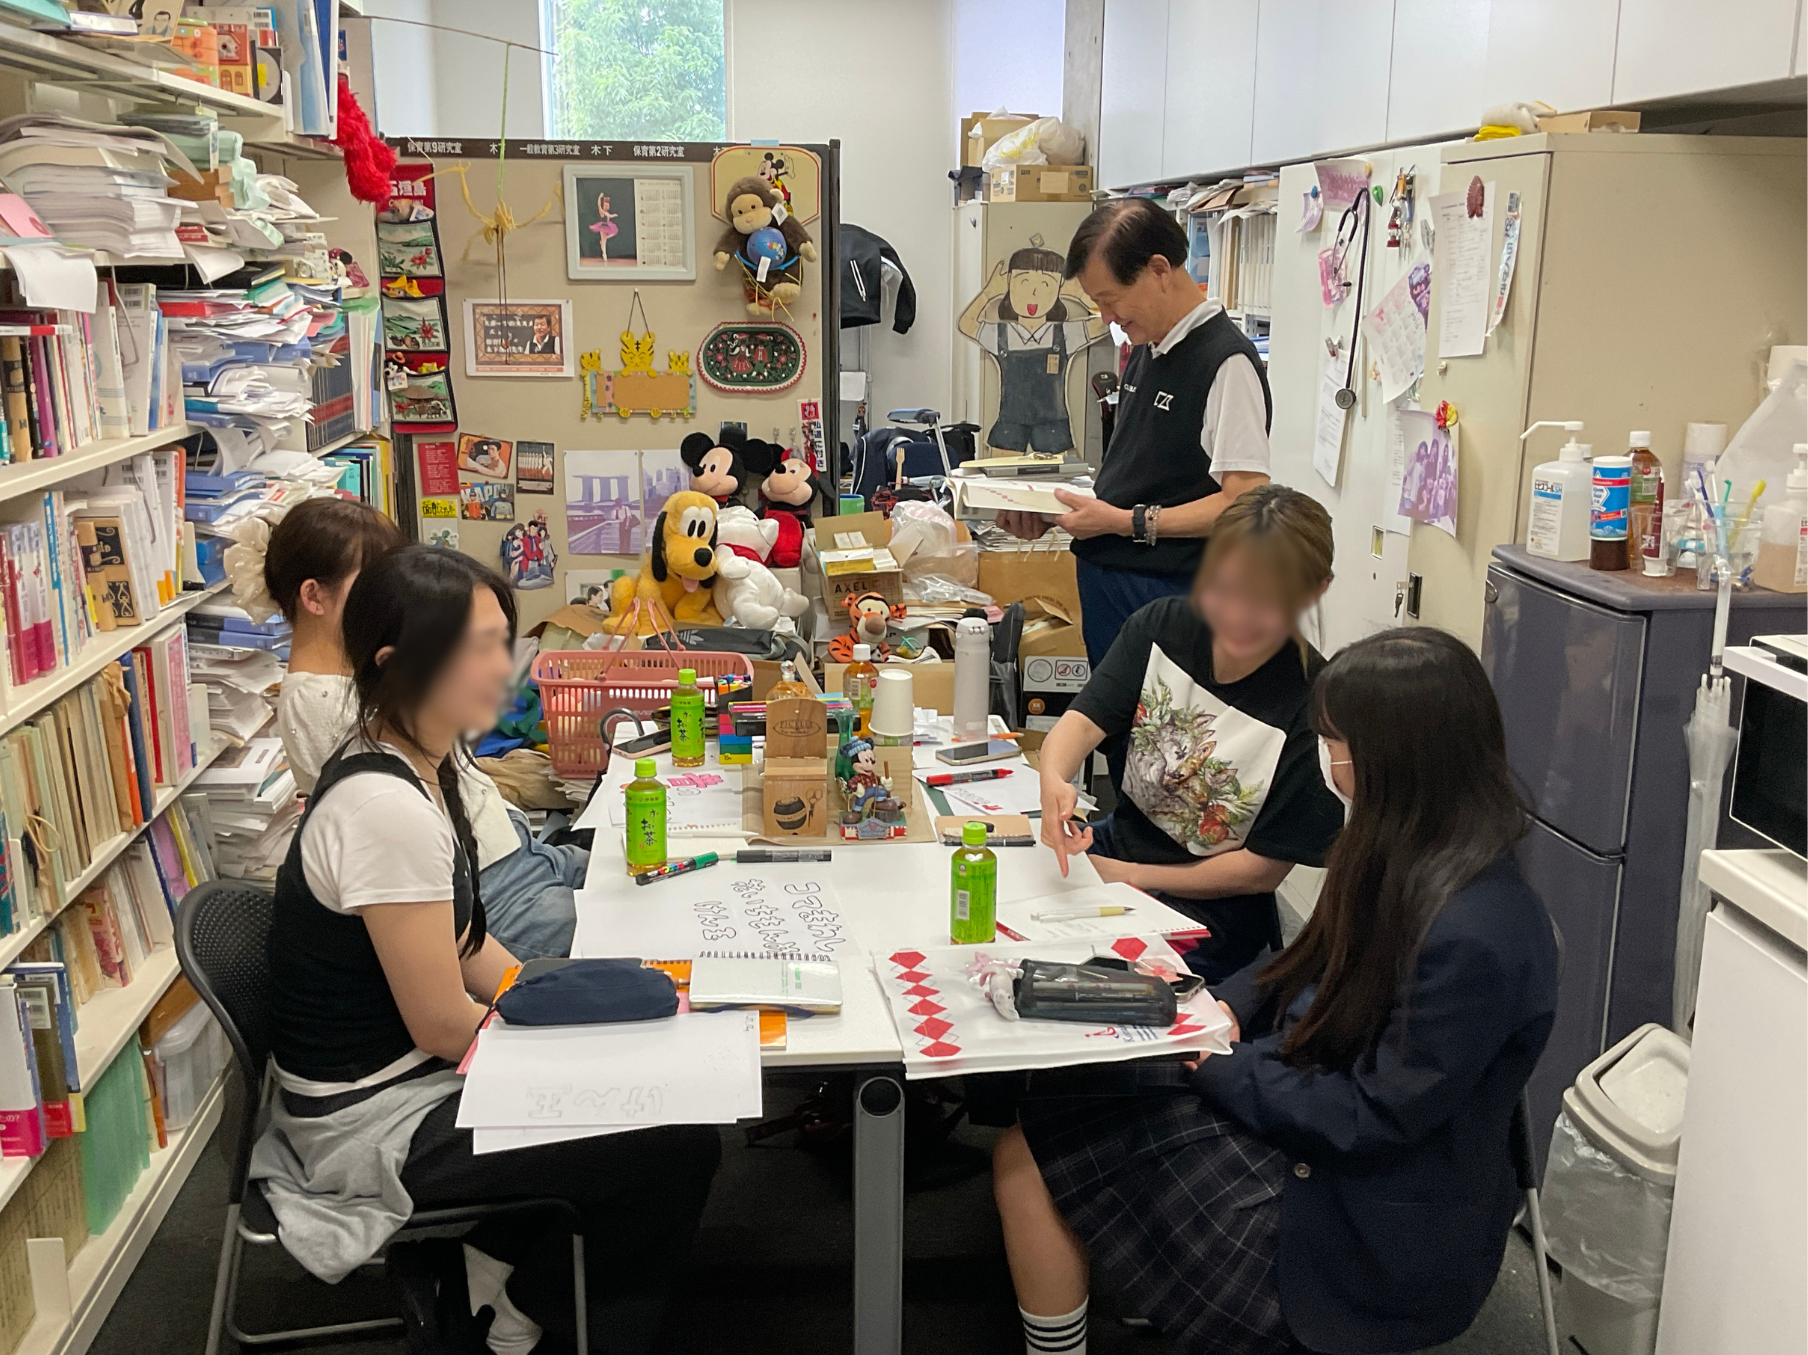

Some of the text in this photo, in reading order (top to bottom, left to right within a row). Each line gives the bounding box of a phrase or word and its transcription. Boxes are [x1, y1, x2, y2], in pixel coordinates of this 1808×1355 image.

[590, 144, 613, 156] 木下
[633, 145, 685, 157] 保育第2研究室
[834, 581, 868, 594] AXEL
